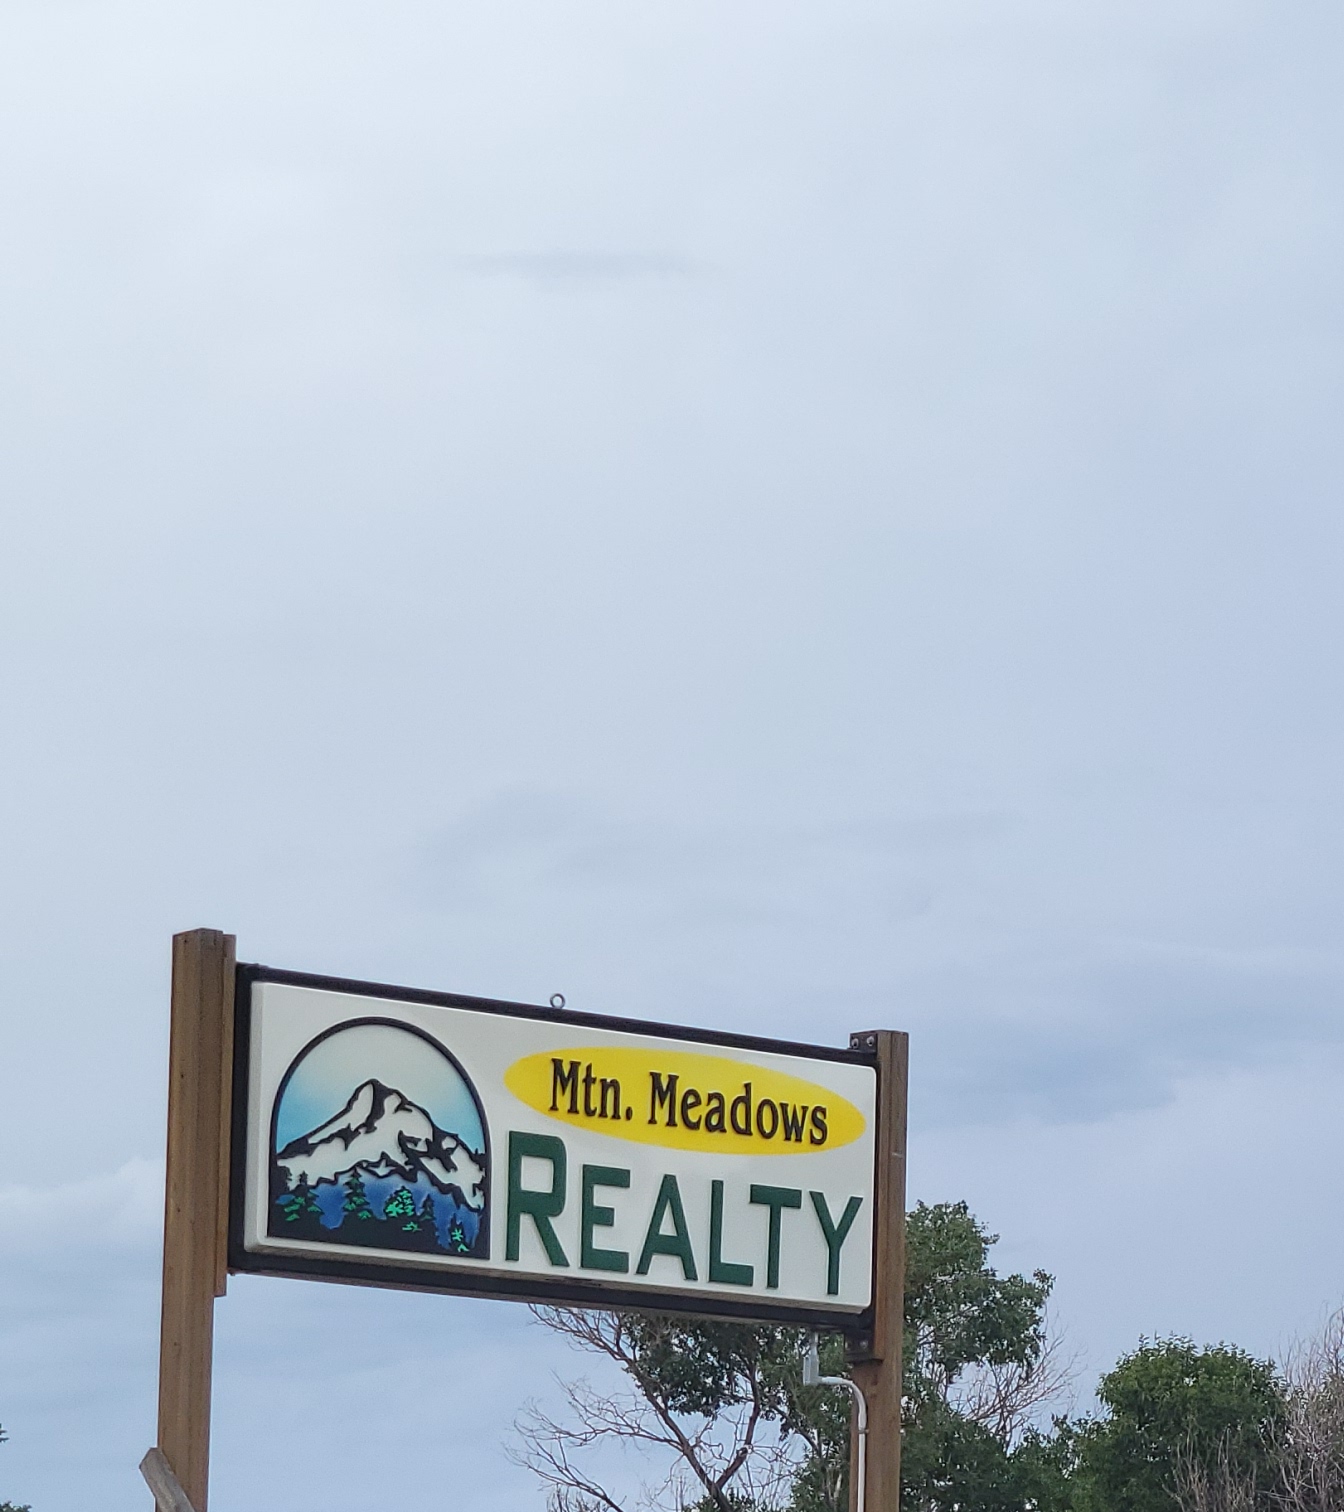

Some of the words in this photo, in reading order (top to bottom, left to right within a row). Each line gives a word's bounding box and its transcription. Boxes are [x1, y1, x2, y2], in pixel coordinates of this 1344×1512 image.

[549, 1057, 633, 1121] Mtn.
[648, 1071, 828, 1146] Meadows
[505, 1130, 864, 1296] REALTY
